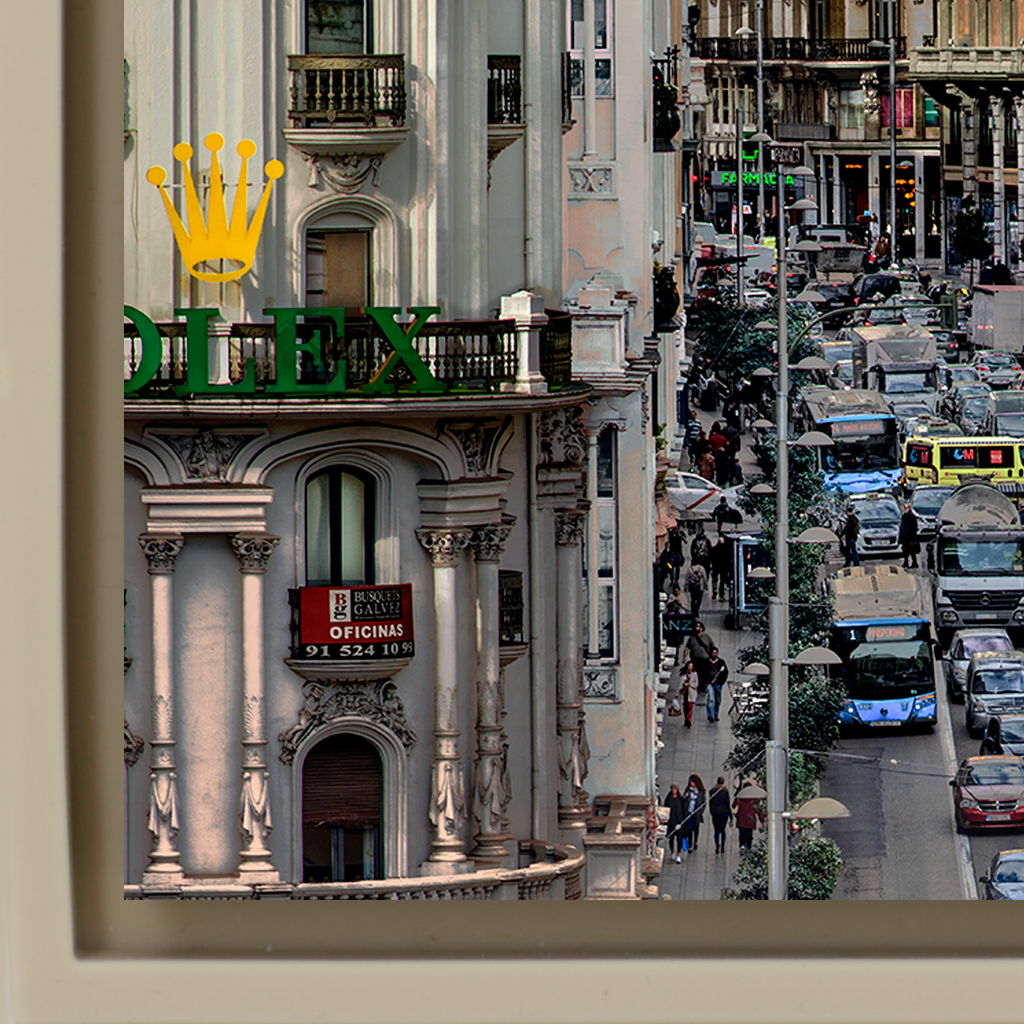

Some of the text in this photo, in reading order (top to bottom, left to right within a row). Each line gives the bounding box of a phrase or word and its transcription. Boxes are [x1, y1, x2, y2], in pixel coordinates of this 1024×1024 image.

[721, 173, 795, 186] FARMACA
[329, 623, 403, 640] OFICINAS
[305, 644, 331, 658] 91
[339, 644, 375, 657] 524
[381, 642, 399, 656] 10
